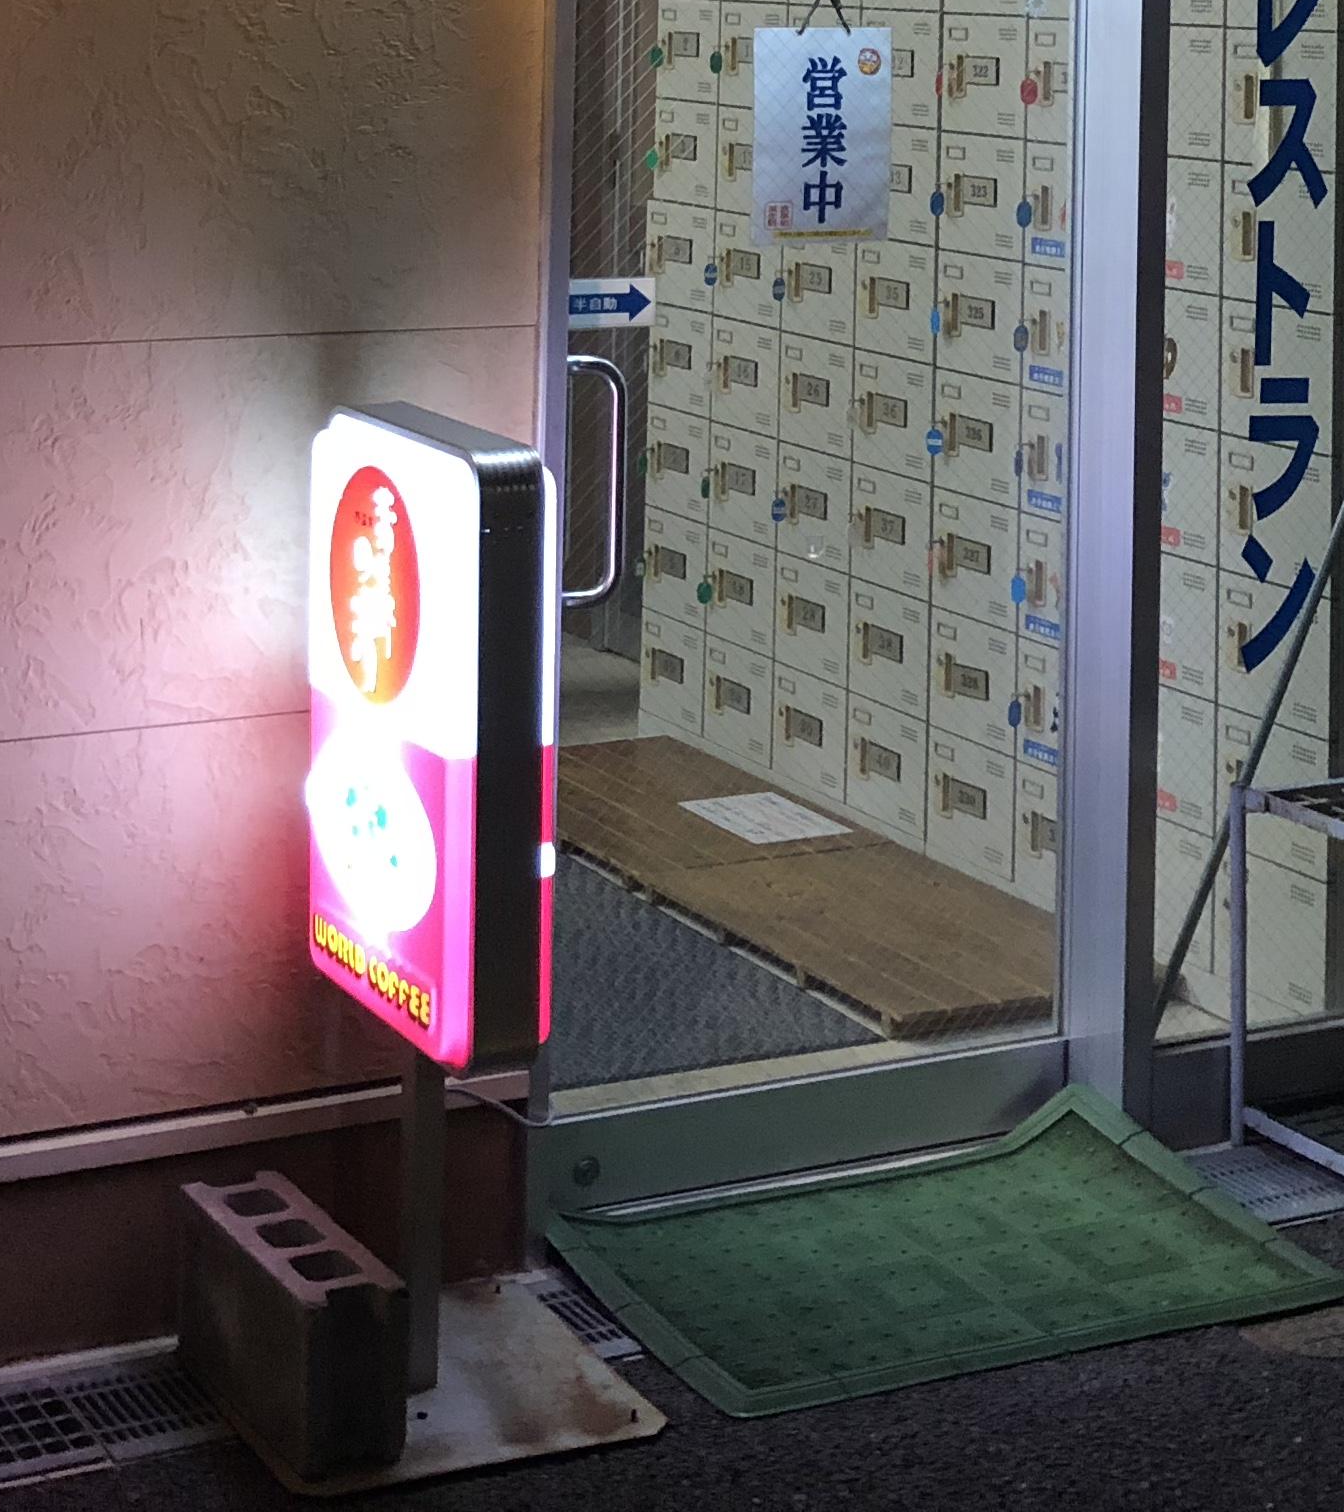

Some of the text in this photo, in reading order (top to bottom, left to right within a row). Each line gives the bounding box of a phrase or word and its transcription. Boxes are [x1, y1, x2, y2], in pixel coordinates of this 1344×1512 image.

[800, 54, 849, 225] 営業中
[572, 296, 618, 312] 半自動
[313, 912, 431, 1033] WORLD COFFEE
